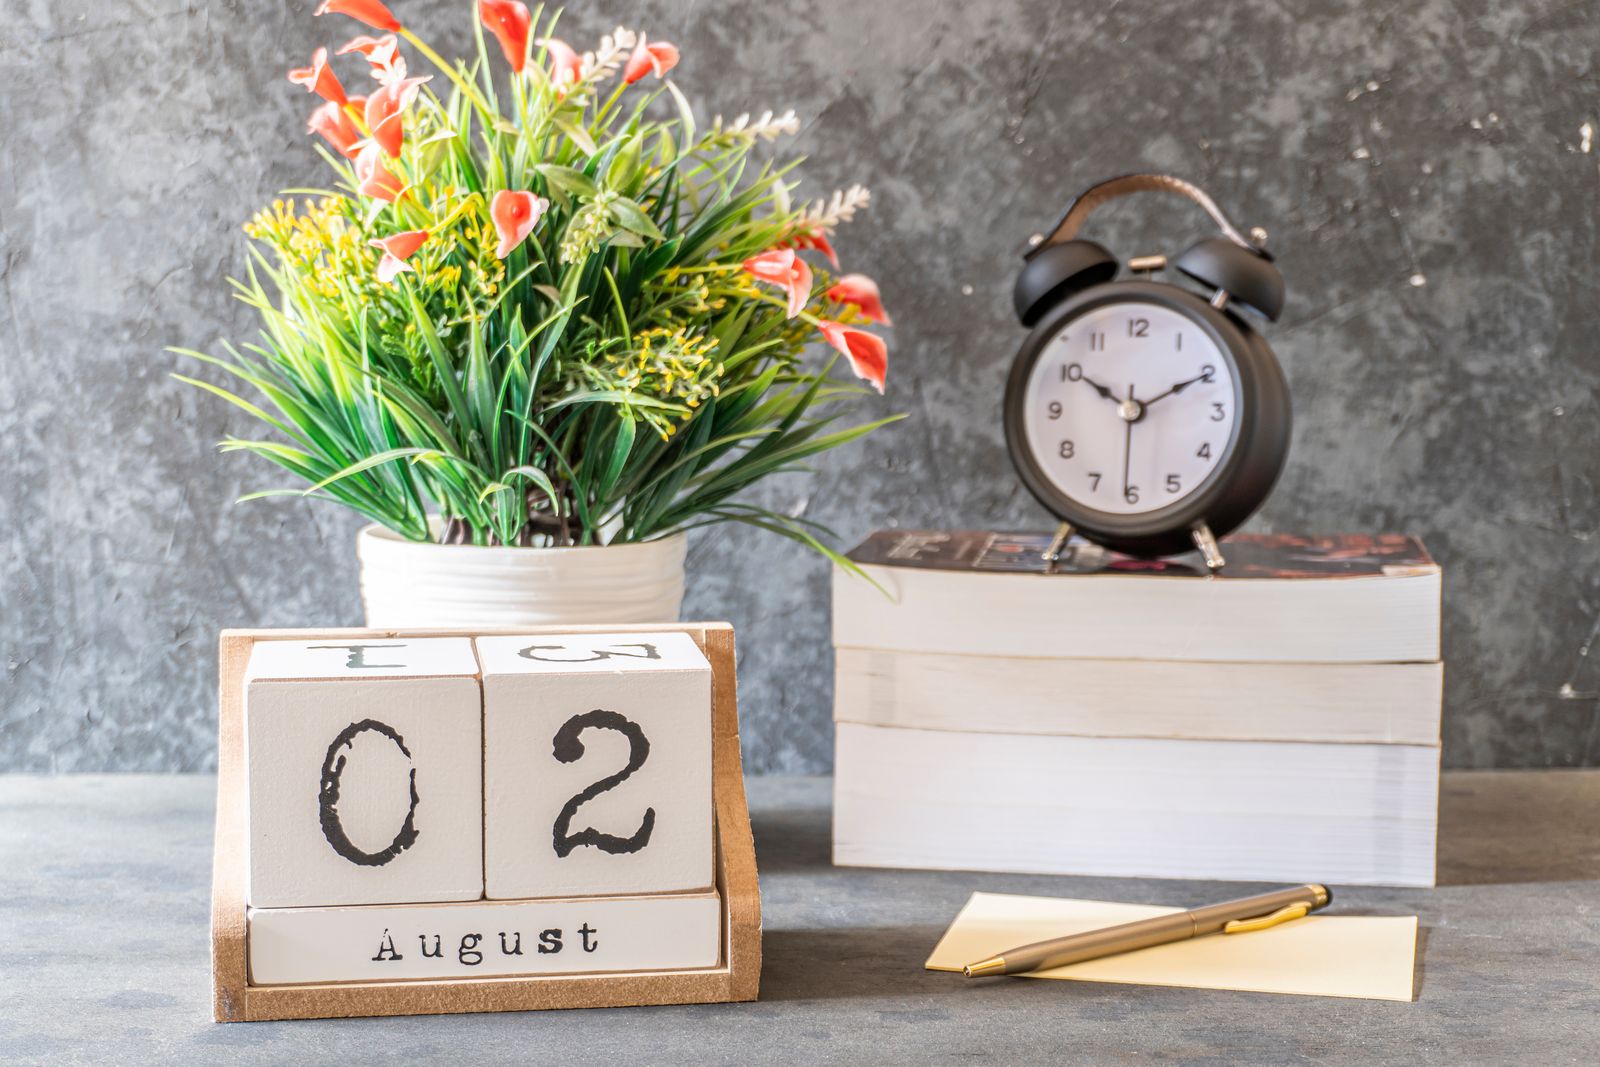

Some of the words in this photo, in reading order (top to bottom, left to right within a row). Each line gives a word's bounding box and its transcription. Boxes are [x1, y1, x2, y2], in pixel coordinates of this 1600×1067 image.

[1129, 319, 1149, 337] 12
[1091, 332, 1105, 351] 11
[1177, 332, 1183, 351] 1
[1060, 363, 1082, 383] 10
[1201, 365, 1216, 384] 2
[1048, 401, 1063, 420] 9
[1210, 402, 1226, 422] 3
[1059, 440, 1075, 459] 8
[1196, 443, 1212, 461] 4
[1088, 473, 1102, 492] 7
[1165, 474, 1182, 493] 5
[1125, 486, 1140, 505] 6
[371, 921, 599, 966] August
